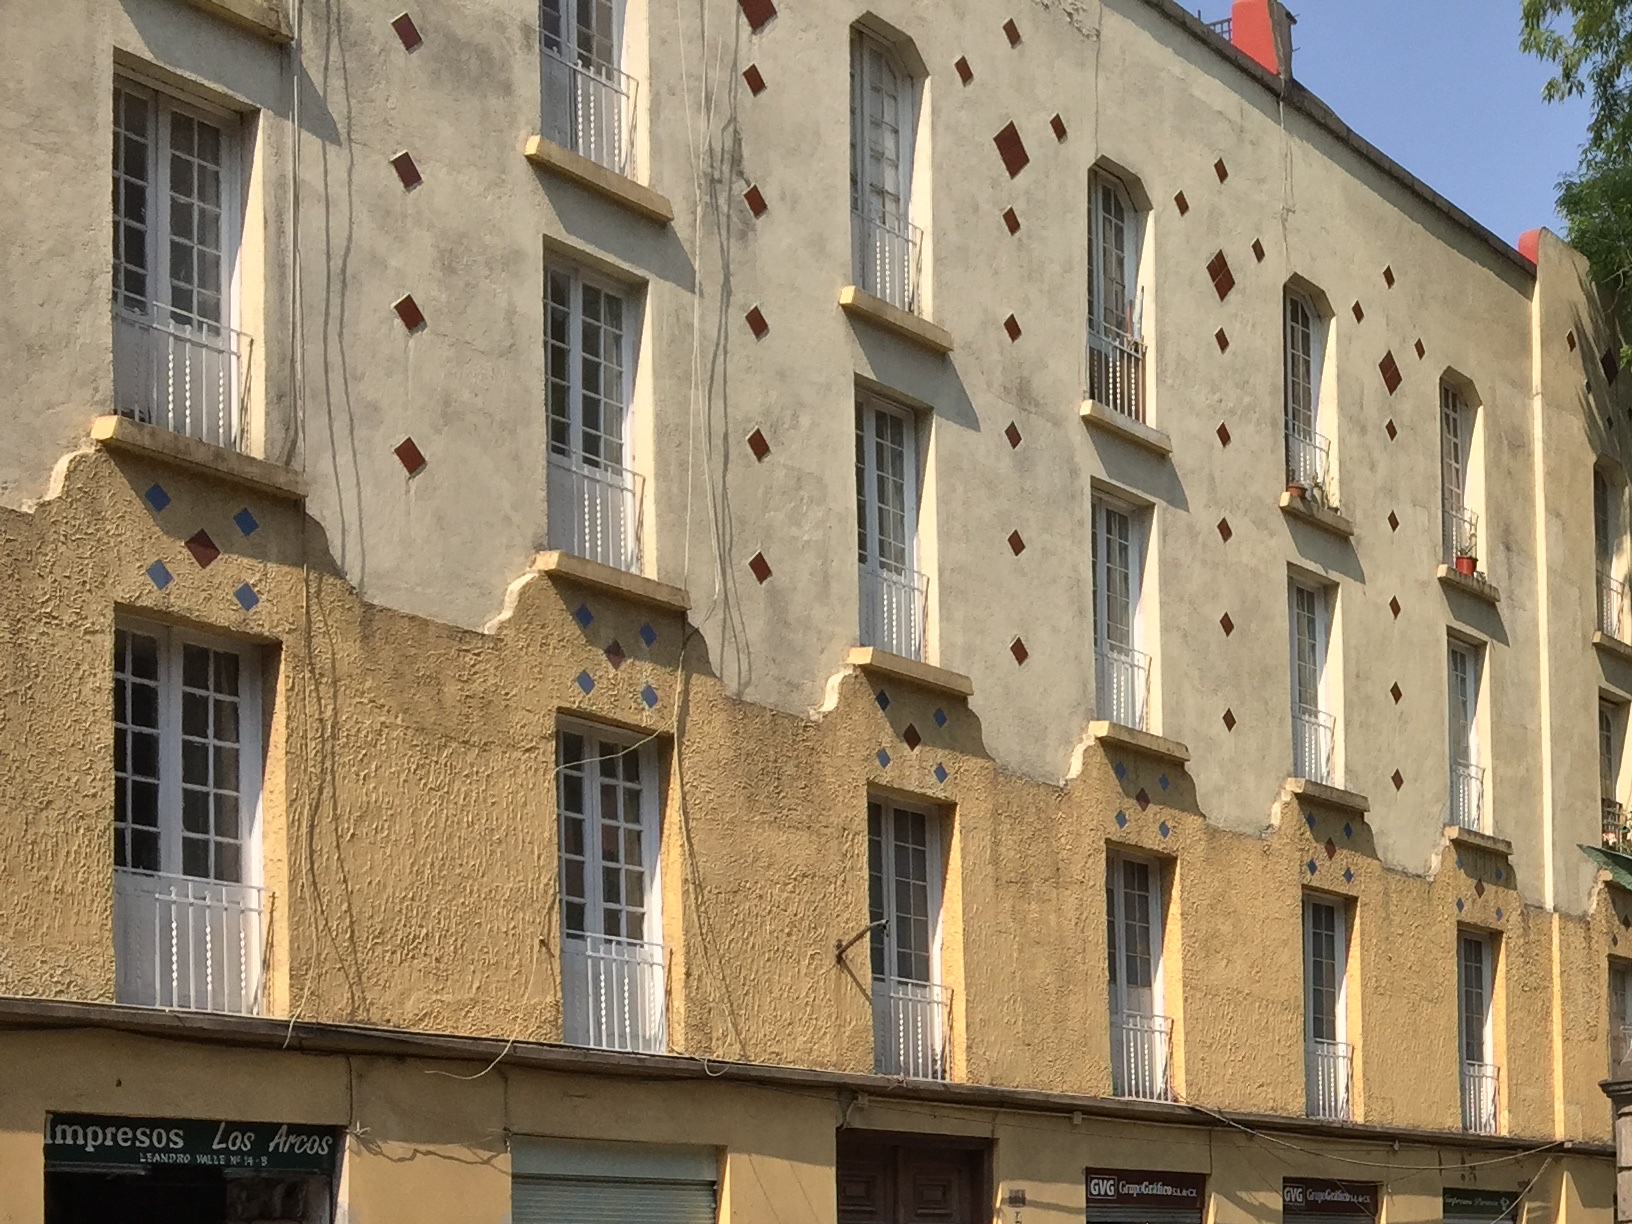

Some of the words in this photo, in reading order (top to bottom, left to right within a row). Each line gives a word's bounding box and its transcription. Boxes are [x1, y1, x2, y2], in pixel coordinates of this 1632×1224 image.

[212, 1121, 255, 1151] Los
[268, 1124, 333, 1155] Arcos
[139, 1152, 191, 1164] LEANDRO
[196, 1154, 225, 1165] VALLE
[1090, 1178, 1115, 1196] GVG
[1283, 1187, 1303, 1203] GVG
